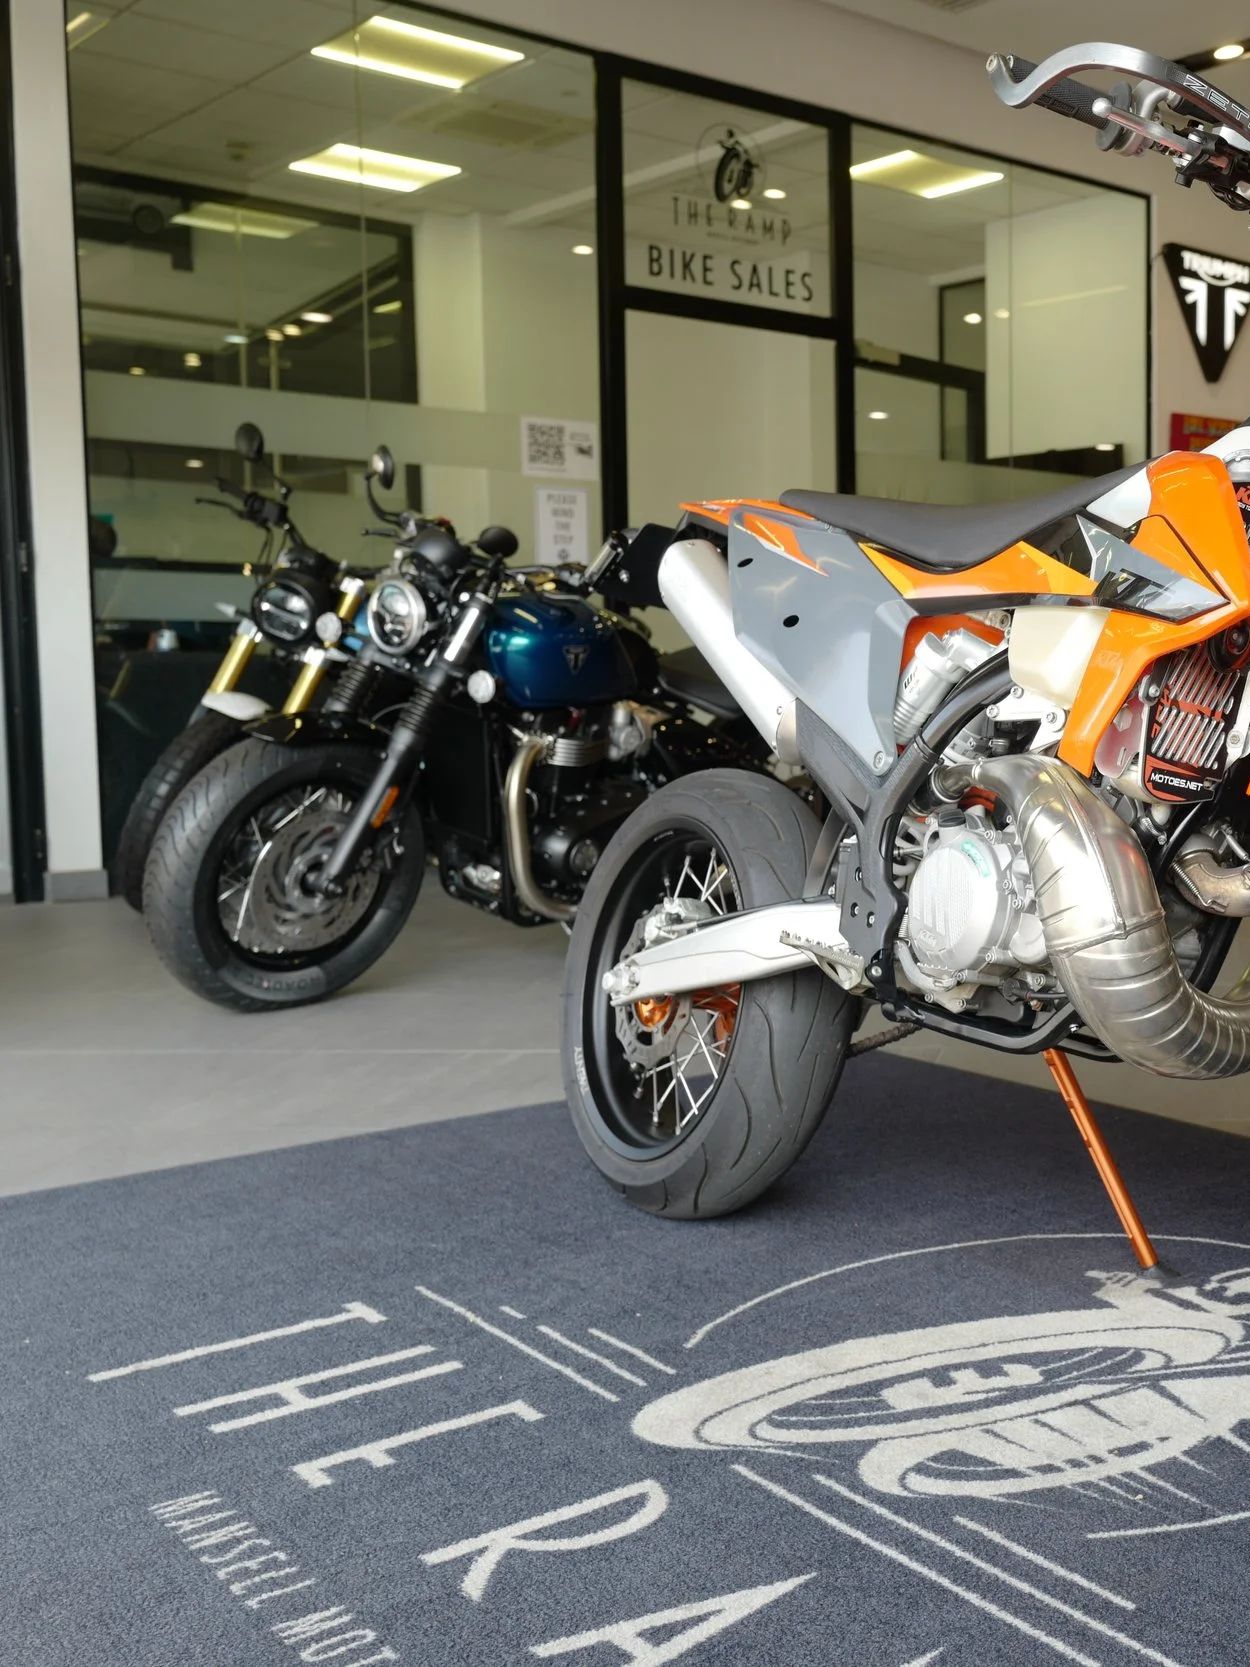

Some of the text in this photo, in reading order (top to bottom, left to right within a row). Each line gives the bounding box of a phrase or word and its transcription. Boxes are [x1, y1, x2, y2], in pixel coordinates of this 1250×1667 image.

[672, 196, 714, 227] THE
[727, 207, 792, 246] RAMP
[648, 244, 814, 302] BIKE SALES
[1180, 250, 1250, 284] TRIUMPH
[1150, 771, 1204, 792] MOTOES.NET
[88, 1301, 546, 1489] THE
[148, 1489, 318, 1609] MANSELL
[418, 1479, 946, 1667] RA
